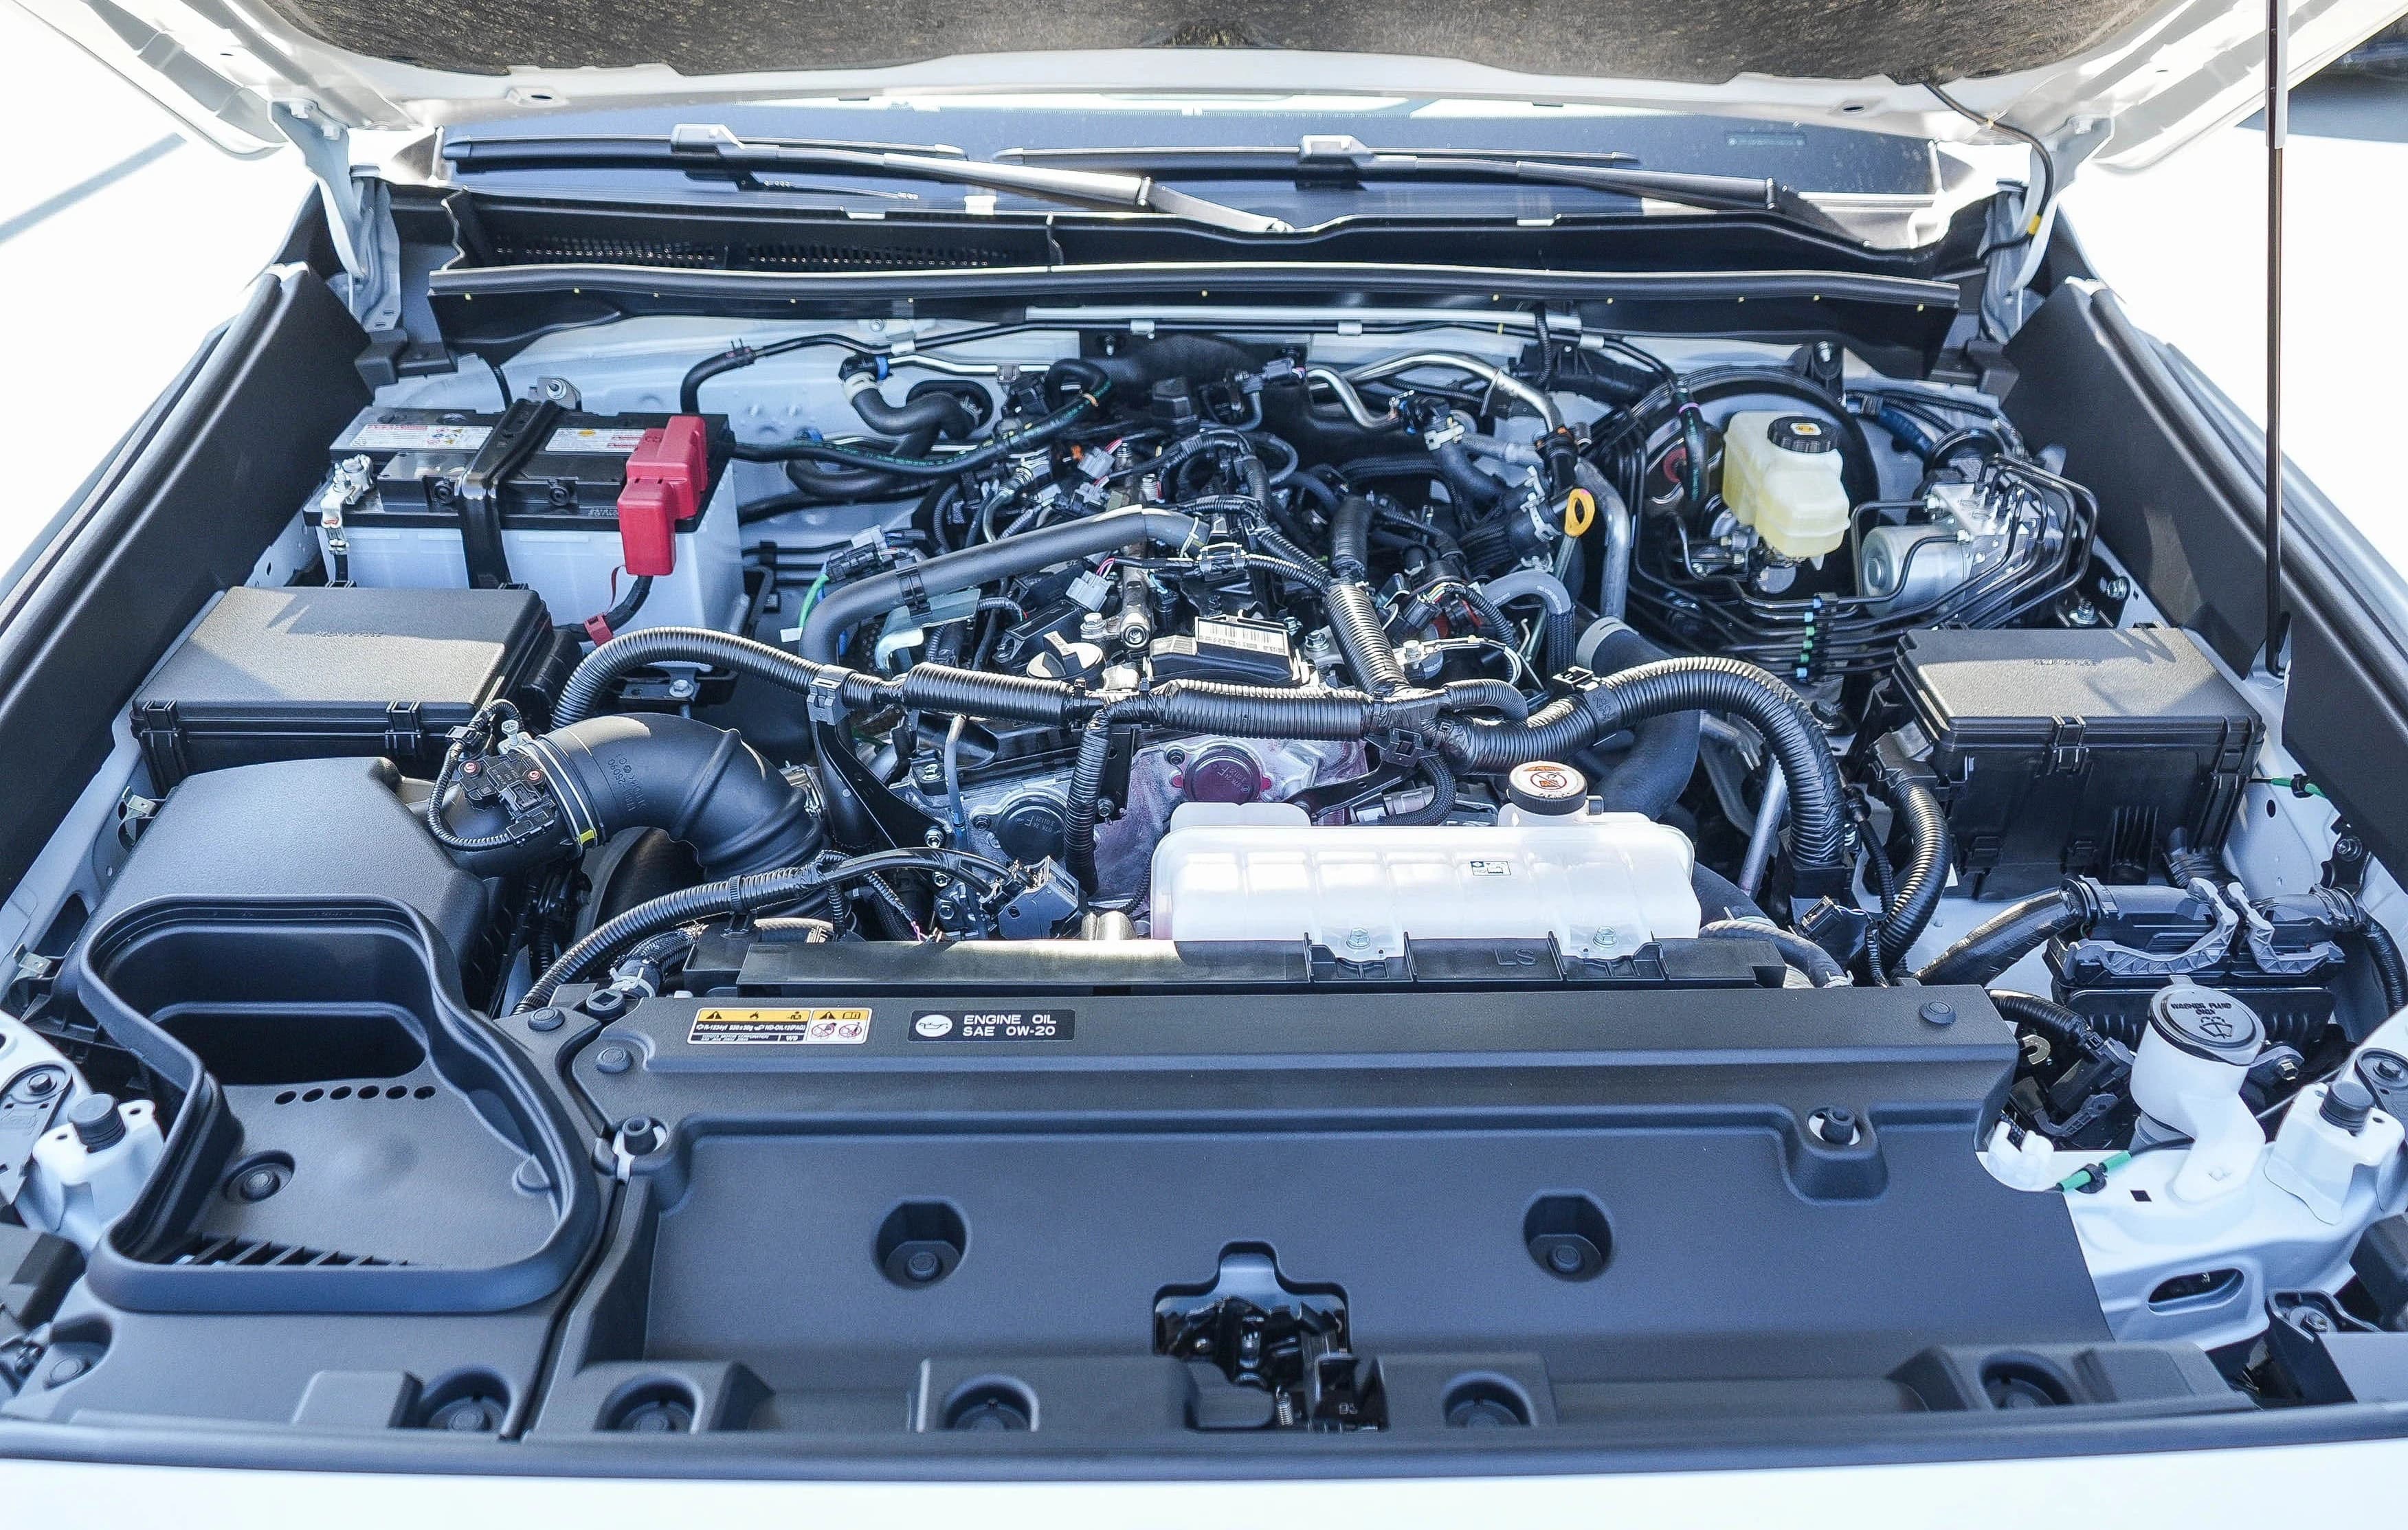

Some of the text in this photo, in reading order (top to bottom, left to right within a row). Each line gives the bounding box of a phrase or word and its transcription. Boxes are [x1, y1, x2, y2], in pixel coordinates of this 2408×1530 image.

[1025, 815, 1034, 826] F
[1494, 949, 1536, 965] LS
[963, 1014, 1056, 1024] ENGINE OIL
[962, 1026, 1056, 1036] SAE 0W-20
